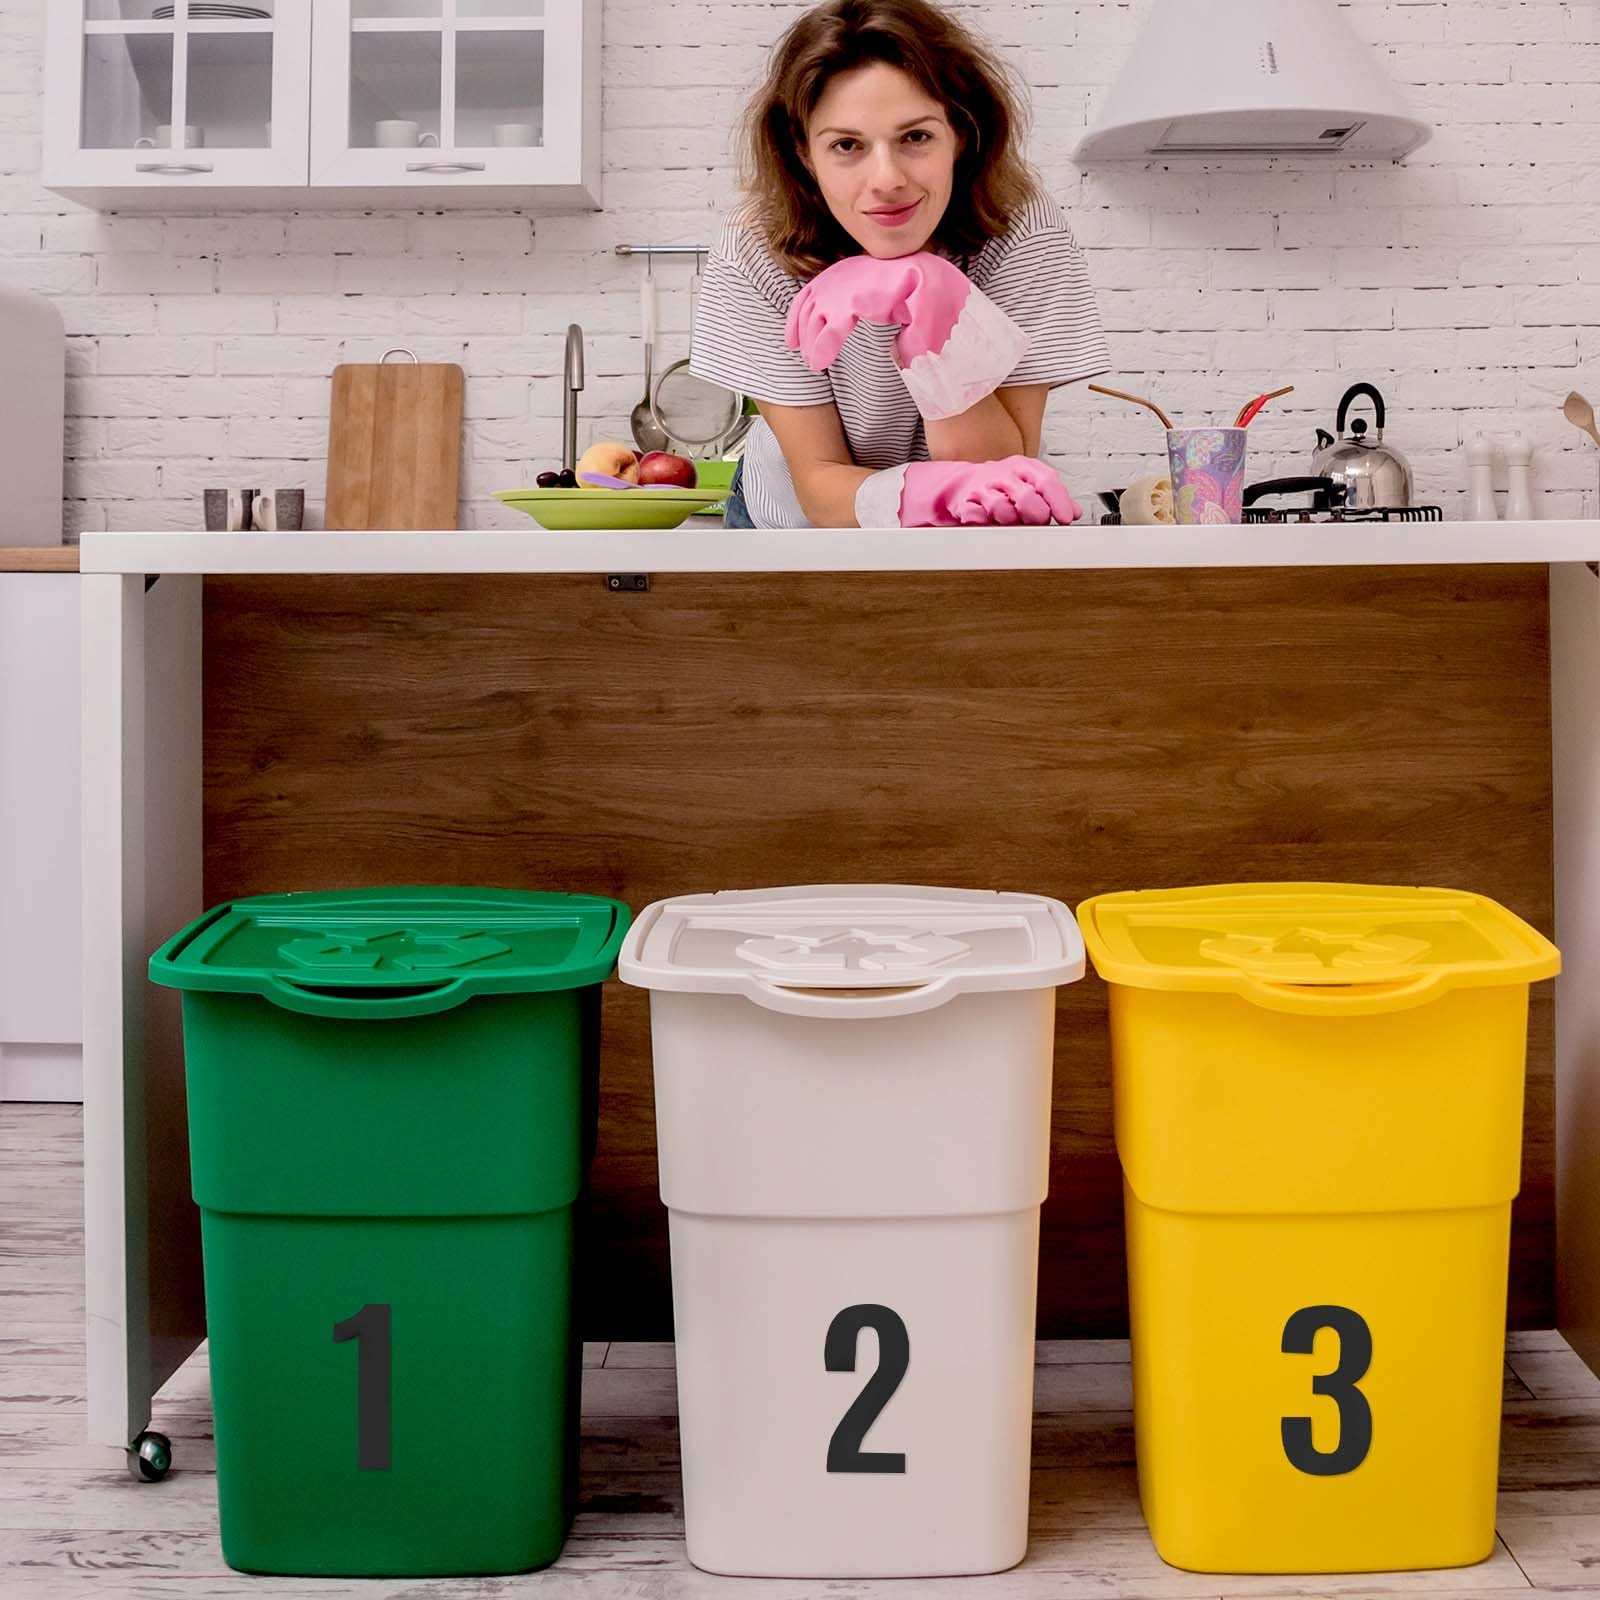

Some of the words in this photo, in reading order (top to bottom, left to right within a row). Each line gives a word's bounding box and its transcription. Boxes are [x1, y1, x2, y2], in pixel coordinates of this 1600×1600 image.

[333, 1304, 392, 1472] 1
[824, 1304, 910, 1474] 2
[1281, 1305, 1373, 1476] 3
